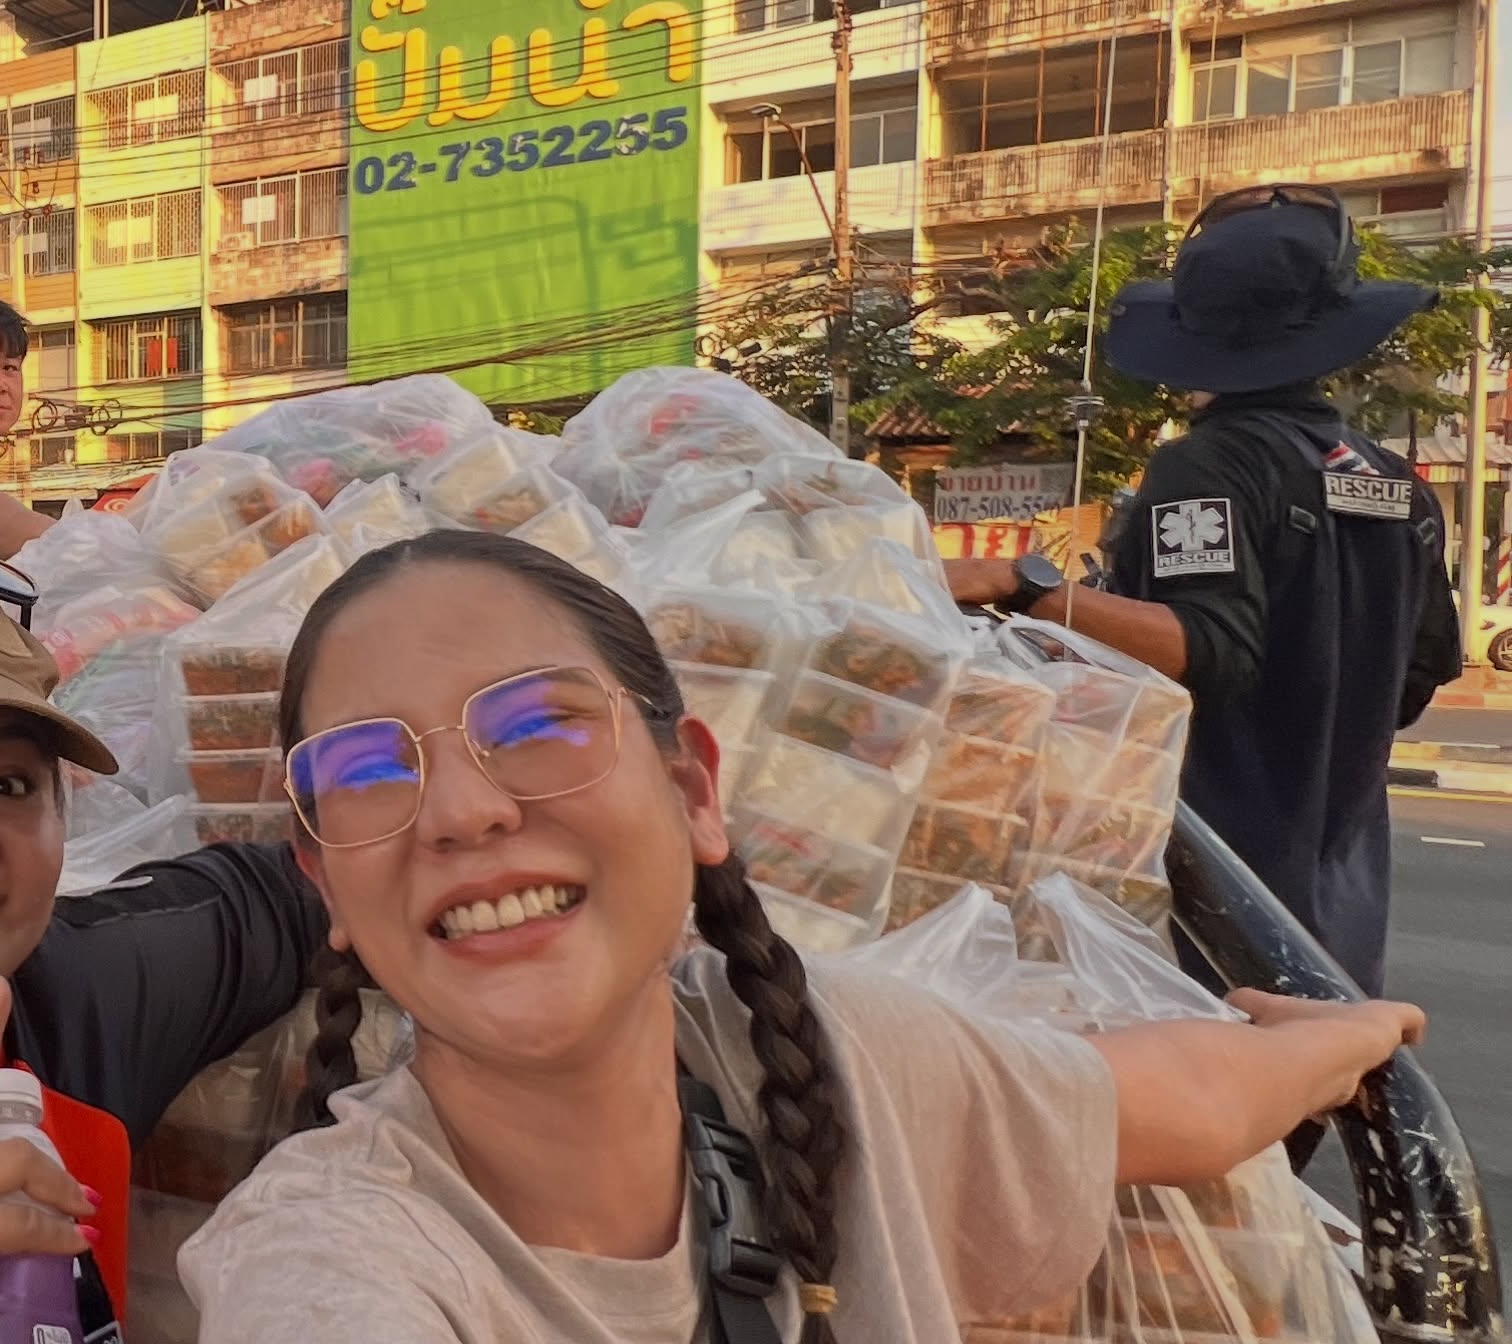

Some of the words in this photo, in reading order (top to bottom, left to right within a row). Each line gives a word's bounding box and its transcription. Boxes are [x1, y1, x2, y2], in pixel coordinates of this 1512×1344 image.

[354, 106, 688, 194] 02-7352255
[1326, 476, 1412, 503] RESCUE
[1158, 551, 1230, 568] RESCUE
